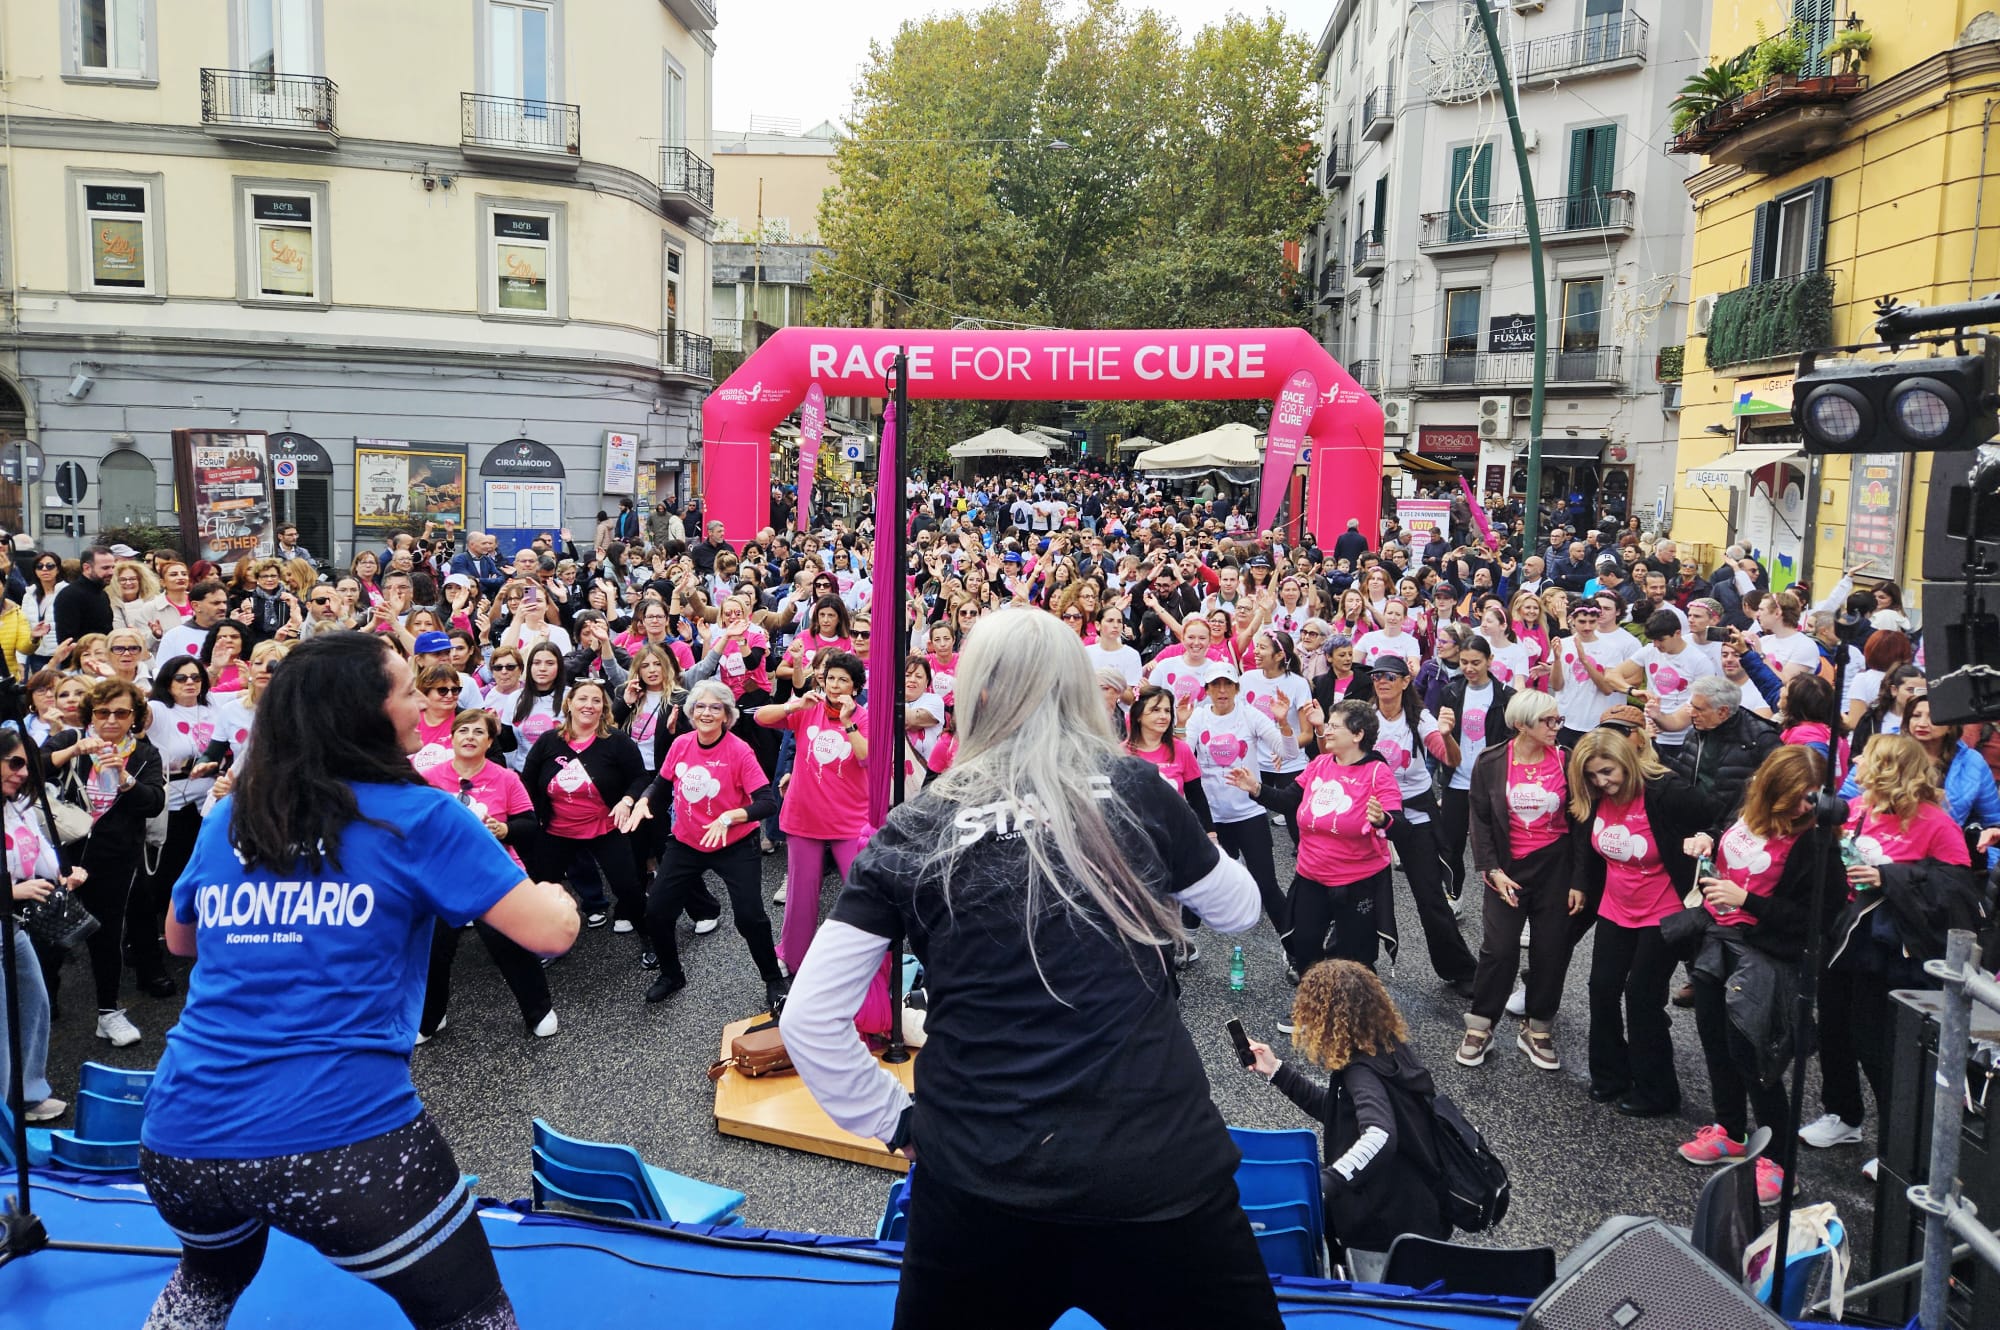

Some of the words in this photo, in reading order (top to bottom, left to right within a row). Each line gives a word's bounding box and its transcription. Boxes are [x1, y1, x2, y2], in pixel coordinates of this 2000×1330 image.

[106, 192, 127, 200] B&B
[273, 202, 293, 211] B&B
[512, 221, 532, 230] B&B
[809, 344, 934, 379] RACE
[951, 346, 1032, 381] FOR
[1043, 346, 1121, 381] THE
[1133, 343, 1266, 380] CURE
[1282, 390, 1305, 404] RACE
[1280, 401, 1297, 414] FOR
[1298, 405, 1313, 417] THE
[1279, 412, 1303, 426] CURE
[199, 458, 225, 466] FORUM
[495, 459, 516, 467] CIRO
[516, 459, 552, 468] AMODIO
[1411, 521, 1434, 530] VOTA
[818, 735, 836, 743] RACE
[816, 746, 833, 754] CURE
[686, 773, 702, 781] RACE
[683, 785, 700, 793] CURE
[955, 775, 1113, 845] STAF
[1602, 831, 1621, 840] RACE
[1601, 845, 1623, 854] CURE
[226, 933, 269, 944] Komen
[272, 932, 303, 943] Italia
[1332, 1125, 1390, 1182] PUMA
